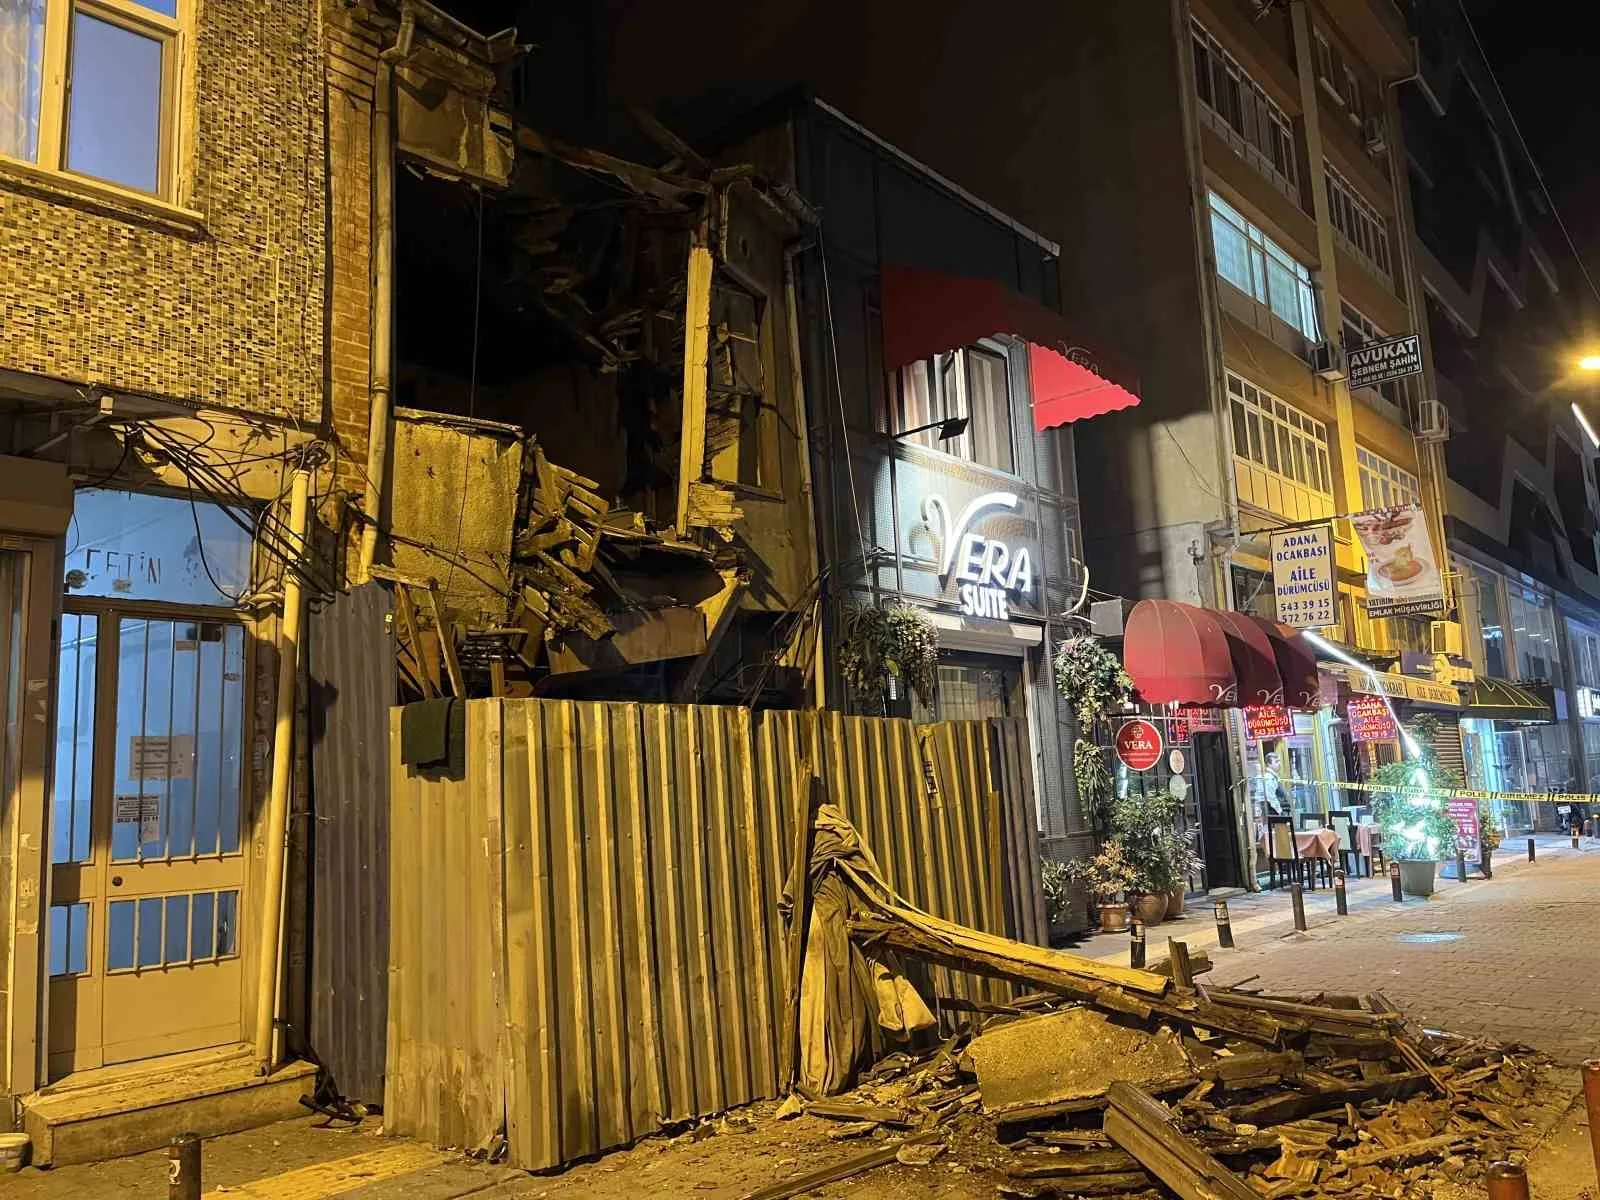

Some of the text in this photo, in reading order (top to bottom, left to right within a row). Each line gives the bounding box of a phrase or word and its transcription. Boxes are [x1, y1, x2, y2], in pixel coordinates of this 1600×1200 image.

[1351, 339, 1416, 368] AVUKAT
[1352, 361, 1388, 379] ŞEBNEM
[1389, 353, 1418, 369] ŞAHİN
[920, 491, 1032, 593] VERA
[1283, 533, 1318, 548] ADANA
[1290, 565, 1317, 582] AİLE
[1277, 579, 1330, 597] DÜRÜMCÜSÜ
[960, 583, 1008, 619] SUITE
[1280, 598, 1330, 612] 543 39 15
[1282, 610, 1329, 625] 572 76 22
[1124, 740, 1153, 750] VERA
